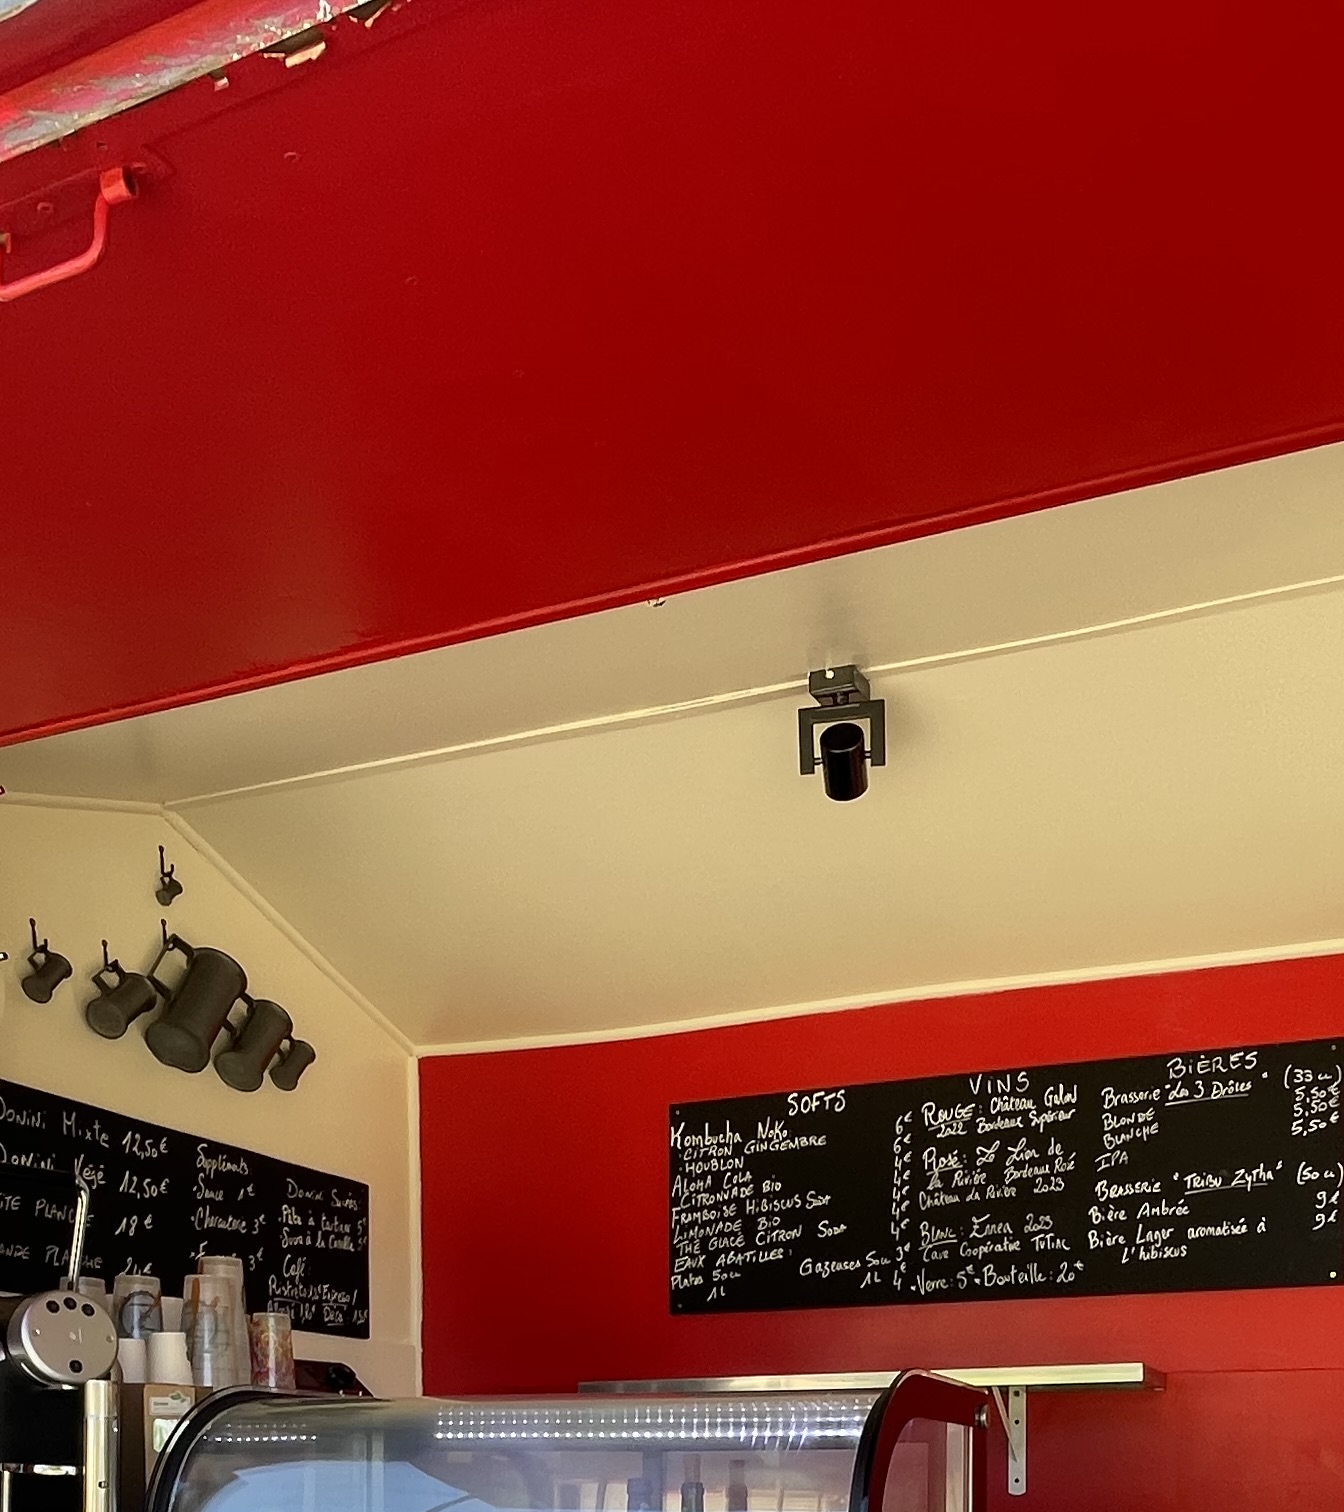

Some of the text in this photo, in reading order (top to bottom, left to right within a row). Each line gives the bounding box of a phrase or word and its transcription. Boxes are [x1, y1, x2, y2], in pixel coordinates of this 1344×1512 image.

[969, 1071, 1030, 1095] VINS
[1101, 1085, 1161, 1110] Brasserie
[1193, 1079, 1205, 1099] 3
[787, 1089, 846, 1116] SOFTS
[990, 1096, 1037, 1115] Château
[1102, 1082, 1341, 1131] BLONDE 5,50€
[62, 1112, 109, 1148] Mixte
[122, 1130, 169, 1160] 12,50€
[670, 1120, 742, 1149] Kombucha
[683, 1111, 913, 1160] CITRON GINGEMBRE 6€
[936, 1122, 968, 1138] 2022
[976, 1116, 1024, 1134] Bordeaux
[1103, 1096, 1340, 1150] BLANCHE 5,50€
[685, 1134, 912, 1178] HOUBLON 6€
[1006, 1137, 1040, 1166] Lion
[1047, 1137, 1064, 1156] de
[1094, 1111, 1340, 1172] IPA 5,50€
[119, 1170, 170, 1199] 12,50€
[671, 1151, 912, 1197] ALOHA COLA 4€
[952, 1167, 987, 1189] Rivière
[1004, 1162, 1050, 1184] Bordeaux
[1054, 1152, 1077, 1173] Rosé
[680, 1170, 911, 1208] CITRONNADE BIO 4€
[918, 1191, 960, 1210] Château
[986, 1184, 1017, 1200] Rivière
[1033, 1176, 1065, 1194] 2023
[1094, 1179, 1162, 1201] BRASSERIE
[35, 1199, 94, 1227] PLANCE
[671, 1204, 737, 1229] FRAMBOISE
[746, 1196, 802, 1215] HIBISCUS
[892, 1186, 910, 1203] 4€
[1088, 1204, 1127, 1225] Bière
[1136, 1198, 1191, 1220] Ambrée
[252, 1214, 266, 1234] 3€
[673, 1200, 910, 1245] LIMONADE BIO 4€
[755, 1225, 802, 1246] CITRON
[890, 1218, 910, 1241] 4€
[1024, 1213, 1054, 1233] 2023
[1088, 1229, 1126, 1250] Bière
[1136, 1223, 1175, 1247] Lager
[1187, 1217, 1248, 1240] aromatisée
[1256, 1216, 1267, 1234] à
[248, 1247, 264, 1271] 3€
[922, 1247, 949, 1262] Cave
[959, 1236, 1021, 1260] Coopérative
[673, 1255, 706, 1273] EAUX
[799, 1258, 862, 1278] Gazeuses
[893, 1262, 908, 1291] 4€
[956, 1264, 975, 1289] 5€
[1056, 1260, 1085, 1284] 20€
